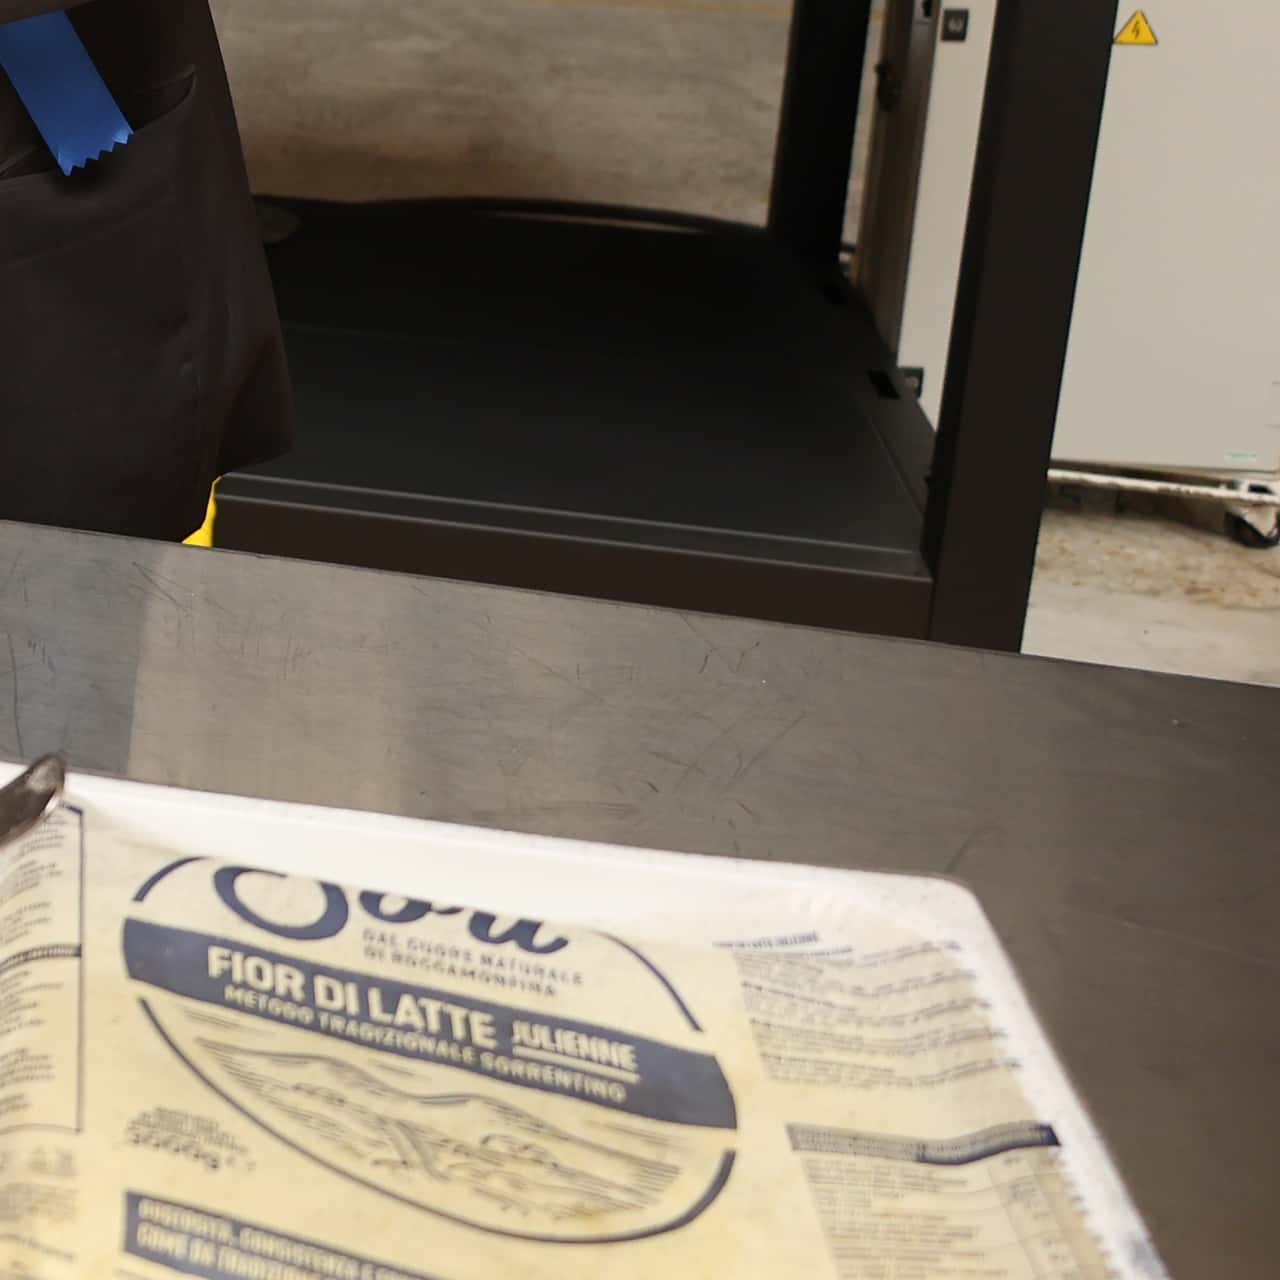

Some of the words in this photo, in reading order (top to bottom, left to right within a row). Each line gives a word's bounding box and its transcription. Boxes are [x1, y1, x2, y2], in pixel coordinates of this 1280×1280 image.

[207, 945, 308, 1003] FIOR
[313, 973, 362, 1018] DI
[366, 984, 498, 1051] LATTE
[511, 1019, 640, 1071] JULIENNE
[223, 983, 315, 1026] METODO
[319, 1011, 478, 1067] TRADIZIONALE
[480, 1051, 628, 1105] SORRENTINO
